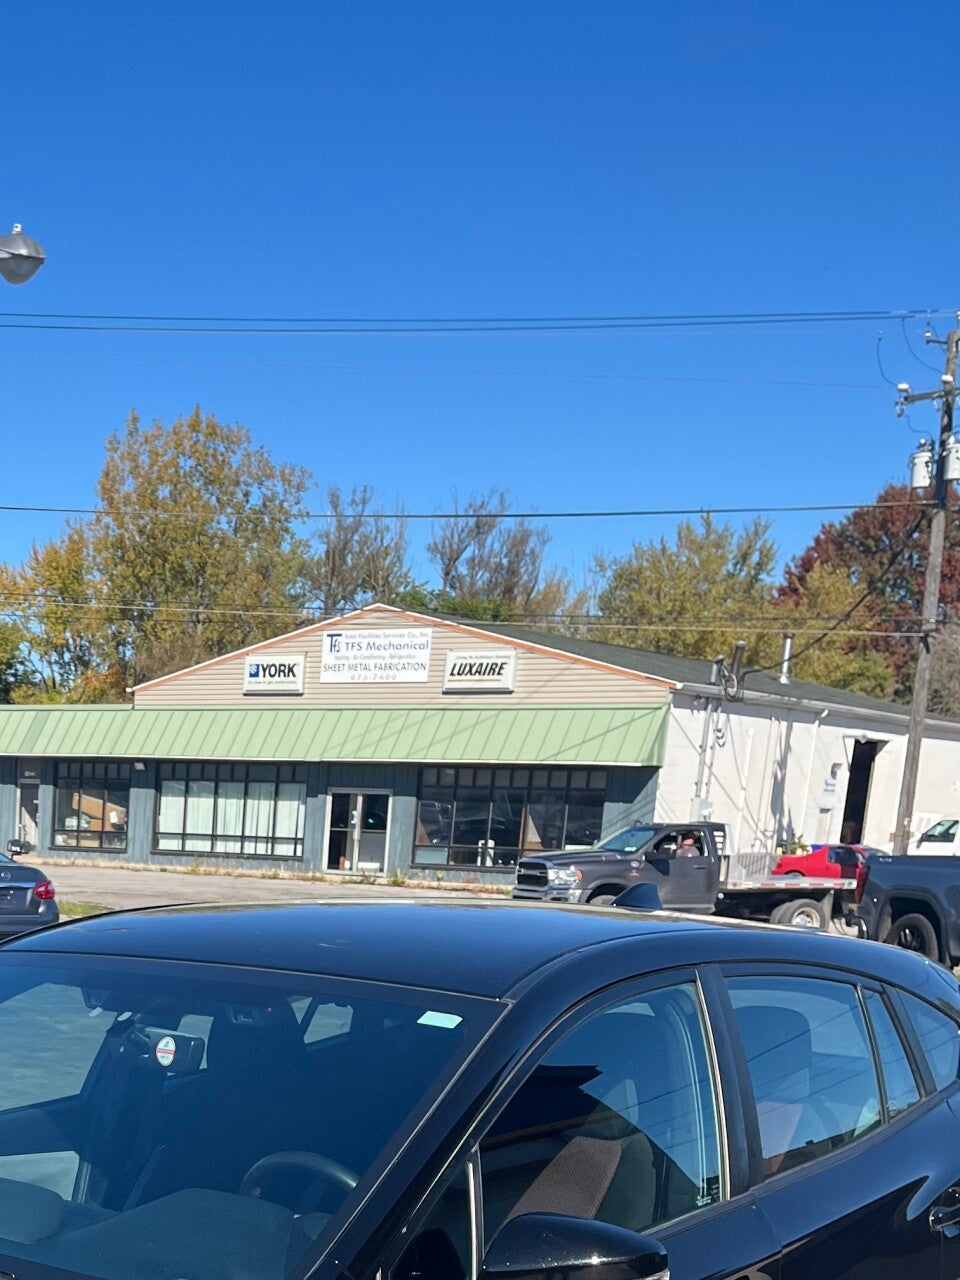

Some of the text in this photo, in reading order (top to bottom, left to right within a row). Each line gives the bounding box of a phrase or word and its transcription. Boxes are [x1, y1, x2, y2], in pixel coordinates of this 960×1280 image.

[345, 640, 429, 651] TFS Mechanical
[261, 663, 296, 678] YORK
[323, 662, 426, 672] SHEET METAL FABRICATION
[449, 662, 507, 677] LUXAIRE
